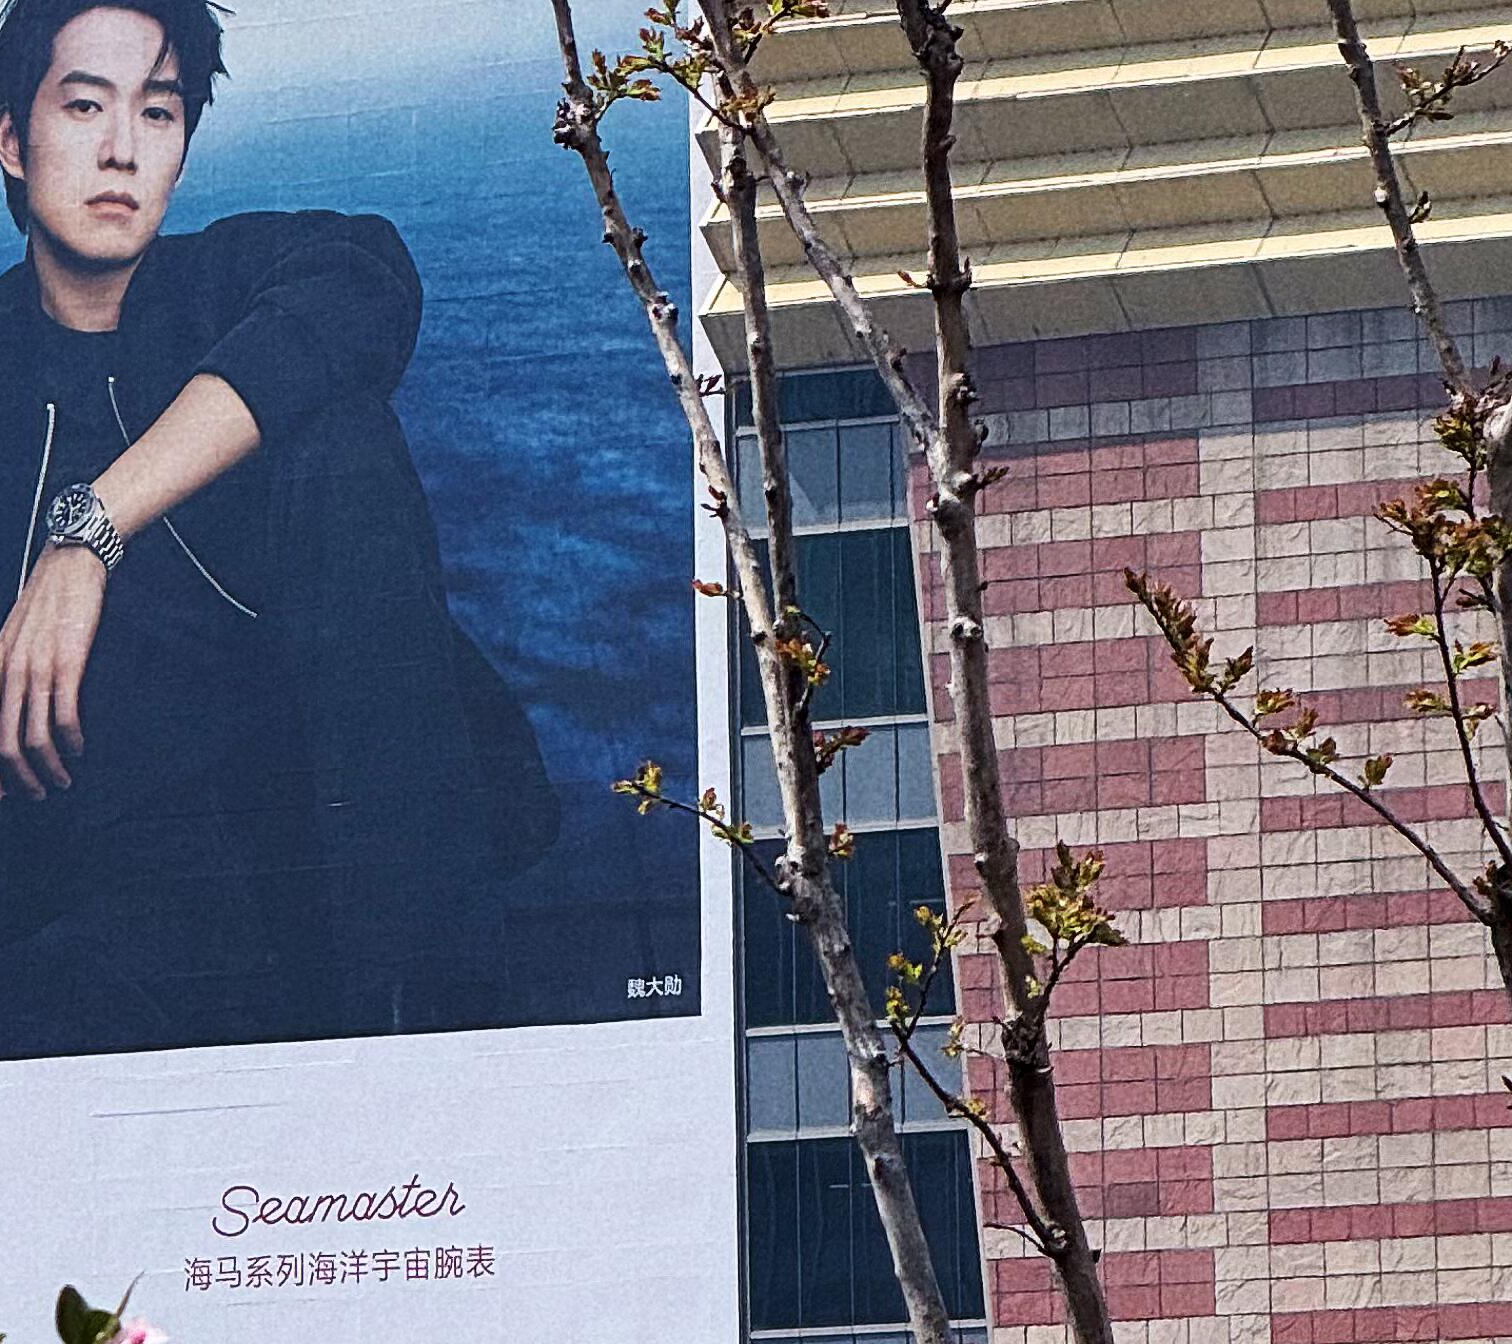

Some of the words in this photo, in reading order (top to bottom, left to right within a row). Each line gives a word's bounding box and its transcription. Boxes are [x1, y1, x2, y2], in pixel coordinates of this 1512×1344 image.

[212, 1174, 466, 1237] Seamaster
[184, 1244, 496, 1292] 海马系列海洋宇宙腕表
